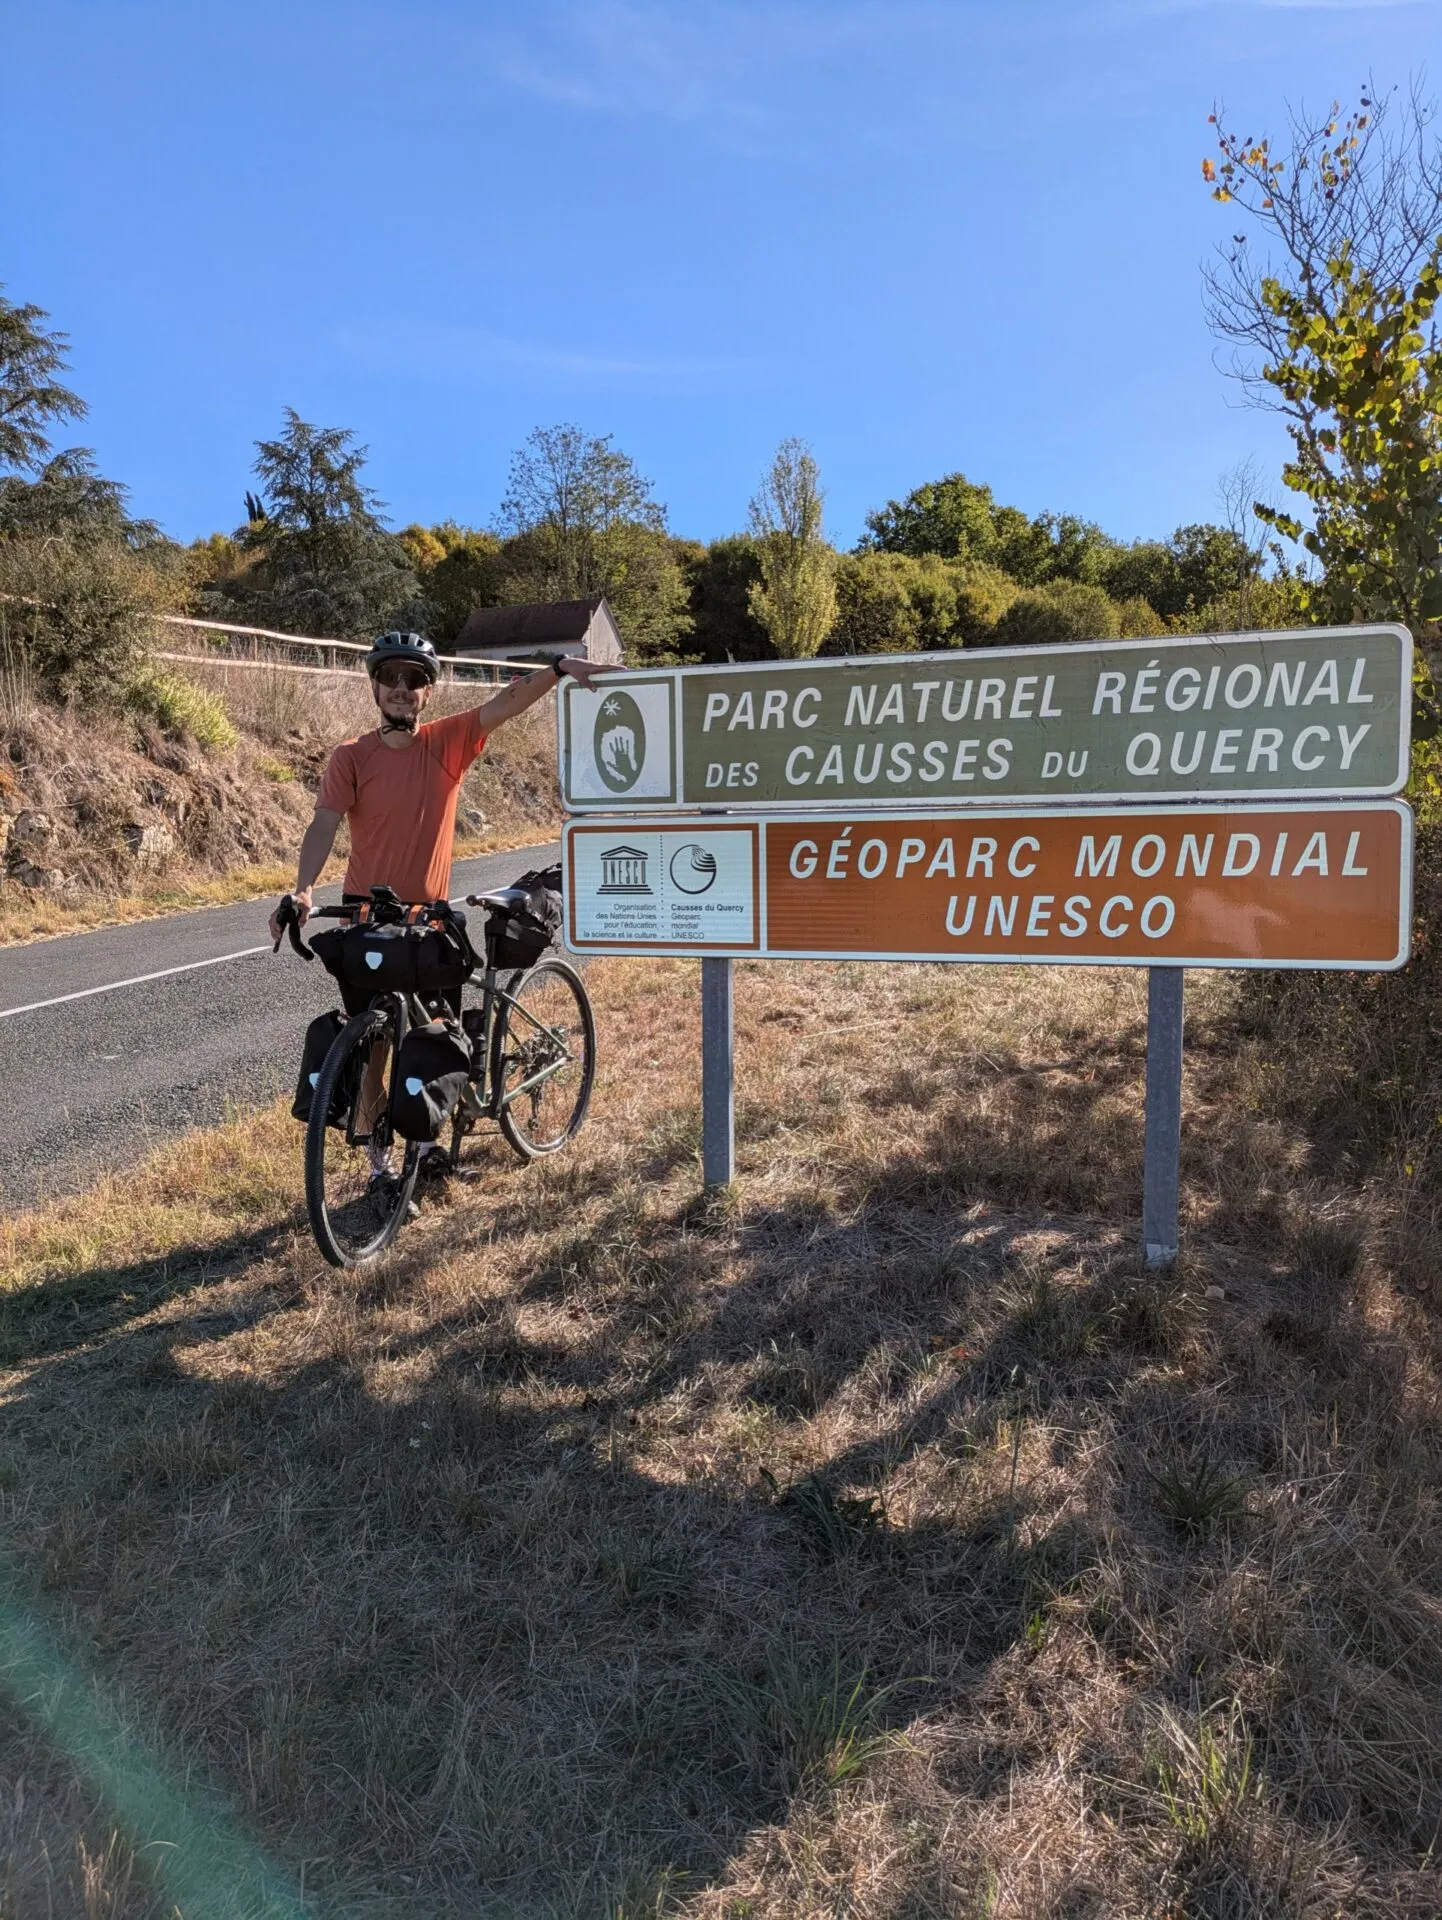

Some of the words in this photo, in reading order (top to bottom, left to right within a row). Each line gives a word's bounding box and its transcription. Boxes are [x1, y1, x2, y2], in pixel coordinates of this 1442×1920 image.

[702, 687, 823, 732] PARC
[843, 675, 1063, 726] NATUREL
[1091, 658, 1374, 715] RÉGIONAL
[705, 762, 760, 788] DES
[784, 738, 1014, 786] CAUSSES
[1041, 750, 1089, 778] DU
[1125, 724, 1371, 776] QUERCY
[789, 826, 1041, 879] GÉOPARC
[1074, 831, 1369, 878] MONDIAL
[603, 860, 647, 884] UNESCO
[613, 903, 657, 912] Organisation
[671, 903, 703, 911] Causses
[704, 903, 715, 911] du
[716, 903, 745, 913] Quercy
[595, 912, 609, 920] des
[609, 912, 636, 920] Nations
[637, 912, 657, 920] Unies
[671, 912, 702, 921] Géoparc
[945, 895, 1176, 938] UNESCO
[604, 922, 620, 930] pour
[671, 922, 699, 930] mondial
[583, 929, 590, 938] la
[591, 930, 617, 938] science
[626, 930, 633, 939] la
[633, 931, 658, 939] culture
[671, 931, 705, 940] UNESCO
